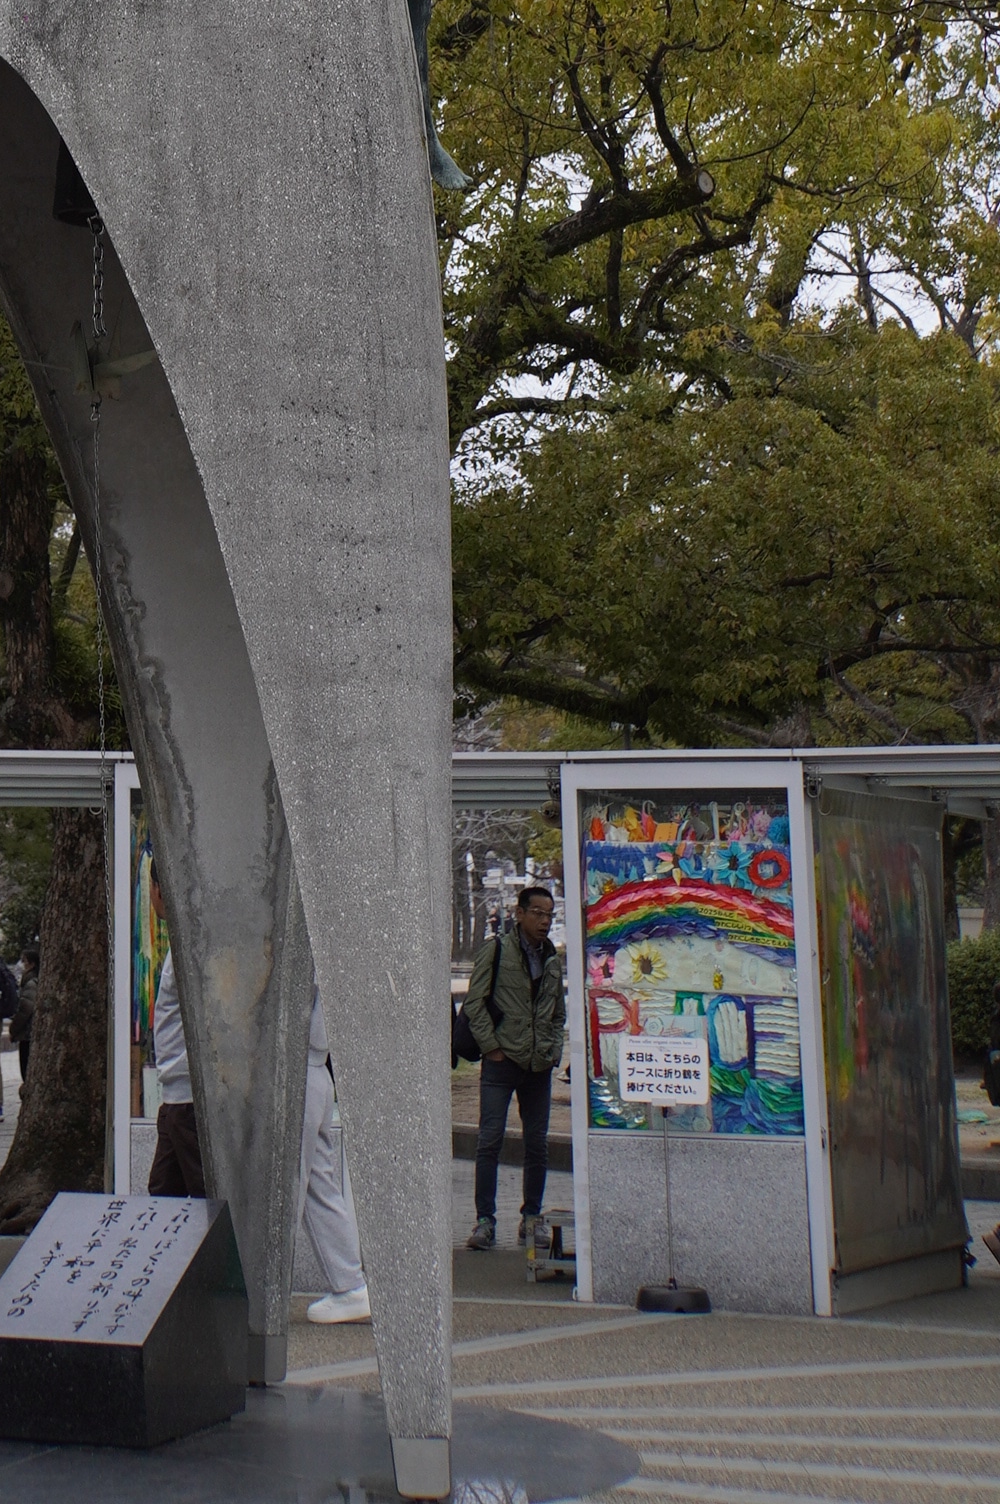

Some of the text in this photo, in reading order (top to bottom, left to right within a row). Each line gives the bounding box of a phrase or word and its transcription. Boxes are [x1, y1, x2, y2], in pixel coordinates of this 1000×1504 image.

[626, 1052, 701, 1064] 本日は、こちらの
[627, 1067, 701, 1080] ブースに折り鶴を
[627, 1082, 697, 1095] 捧げてください。
